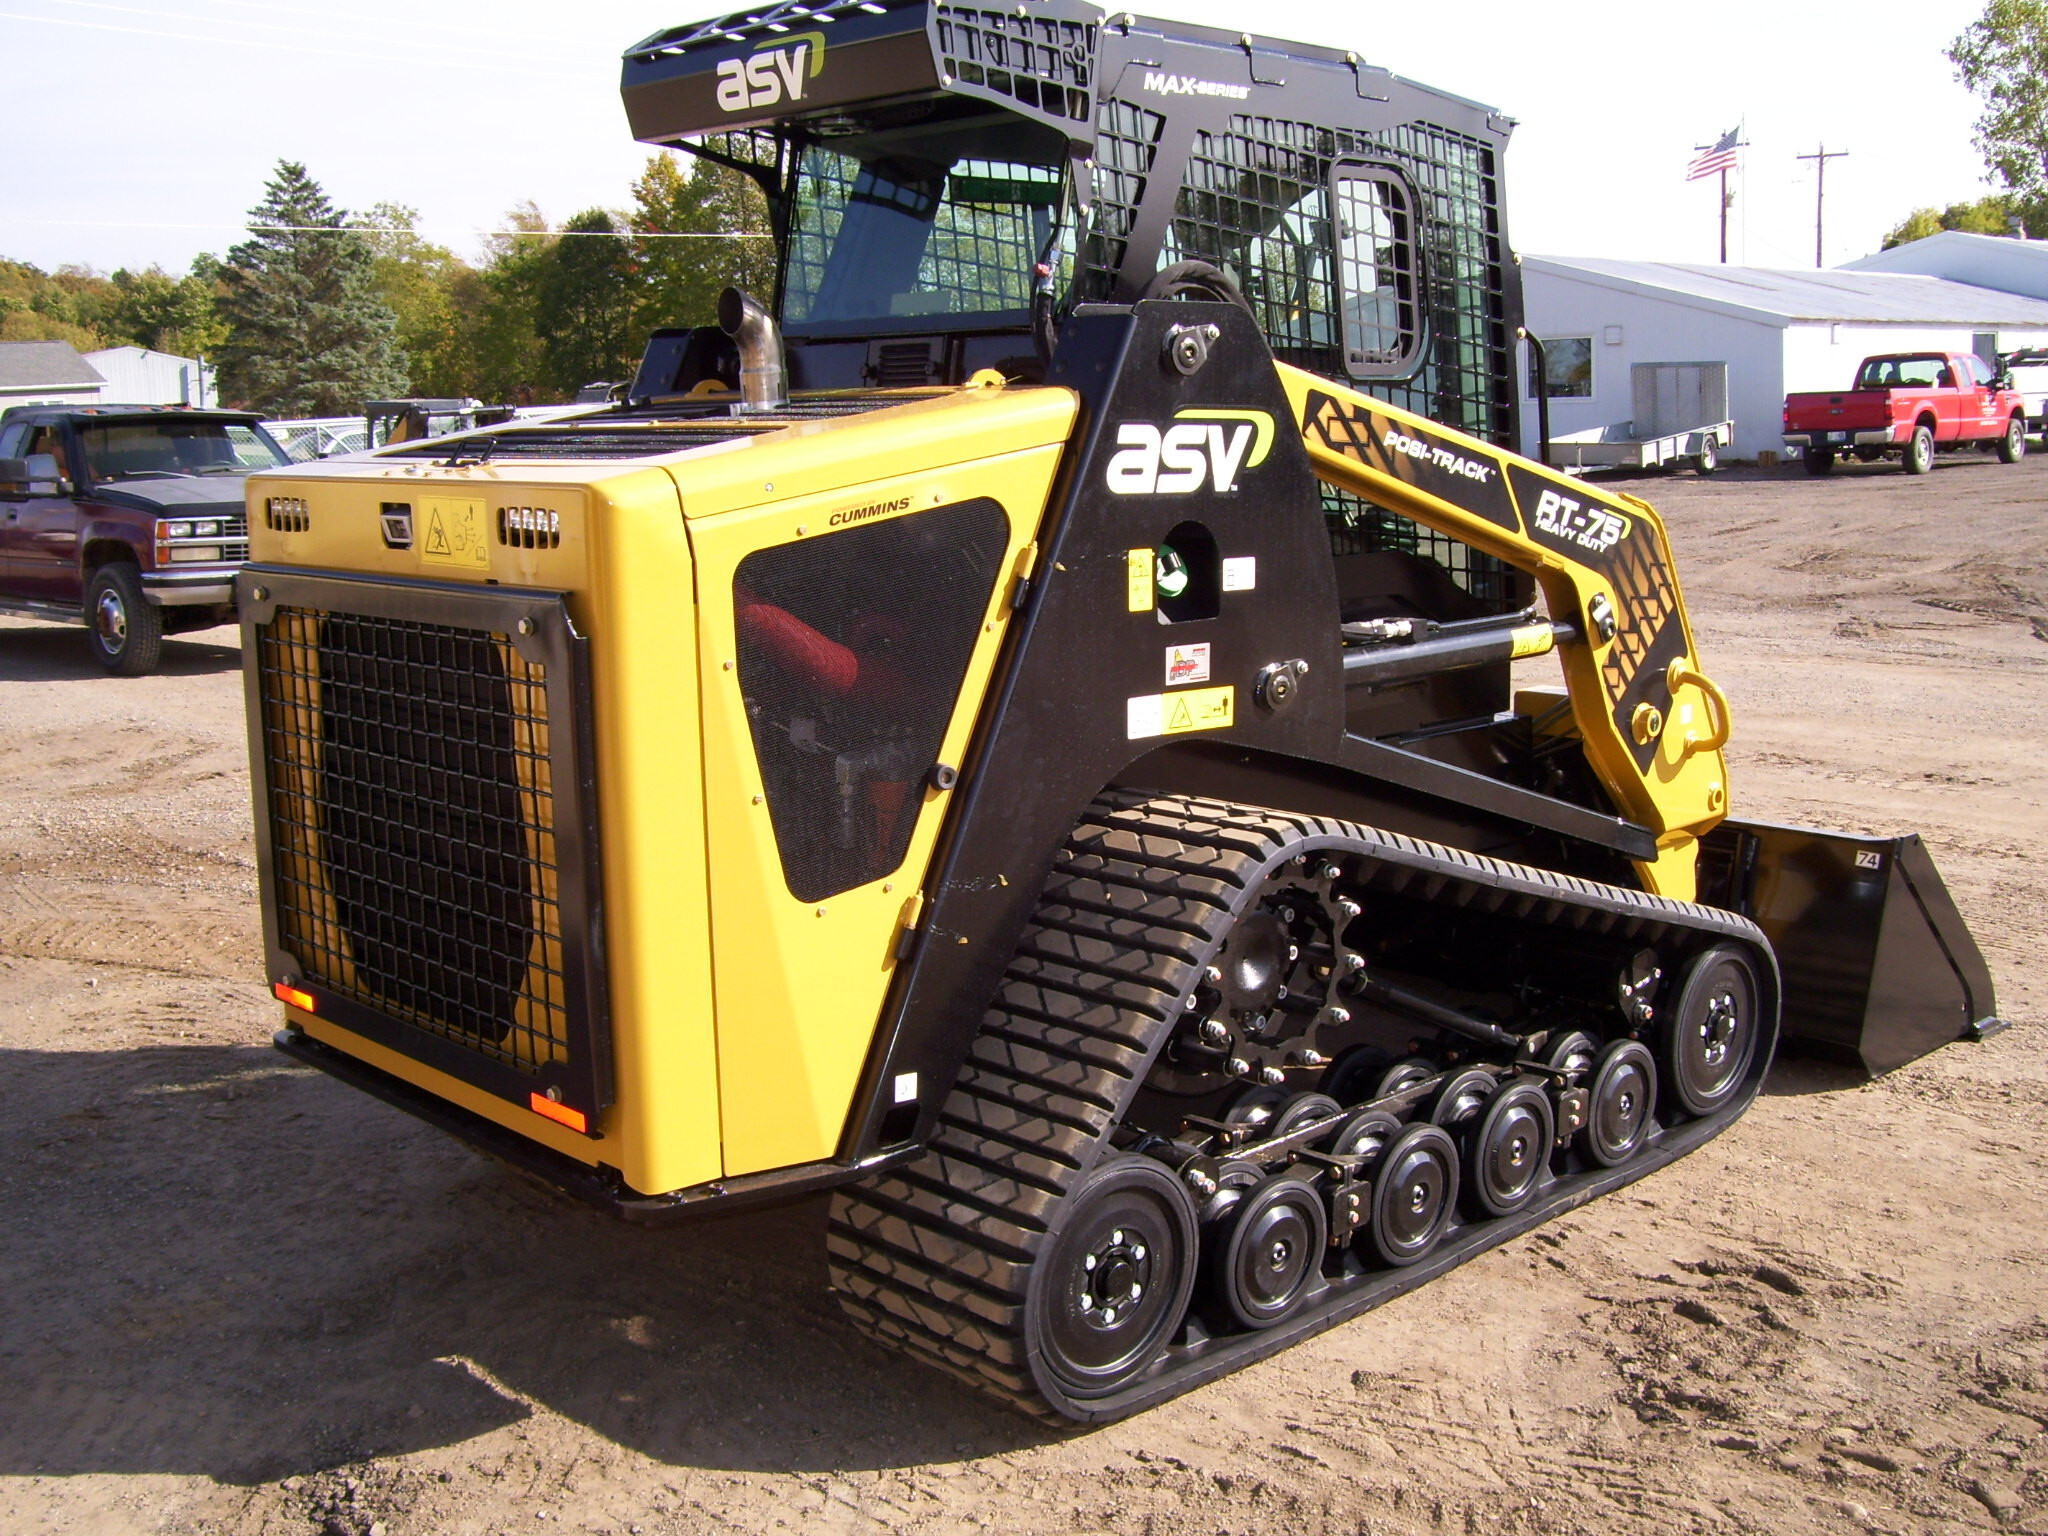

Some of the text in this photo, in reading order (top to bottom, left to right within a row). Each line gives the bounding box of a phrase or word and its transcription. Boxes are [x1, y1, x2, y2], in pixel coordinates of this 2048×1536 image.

[1383, 430, 1490, 483] POSI-TRACK
[829, 497, 911, 527] CUMMINS
[1535, 489, 1623, 545] RT-75
[1534, 515, 1608, 553] HEAVY DUTY
[1859, 852, 1878, 868] 74
